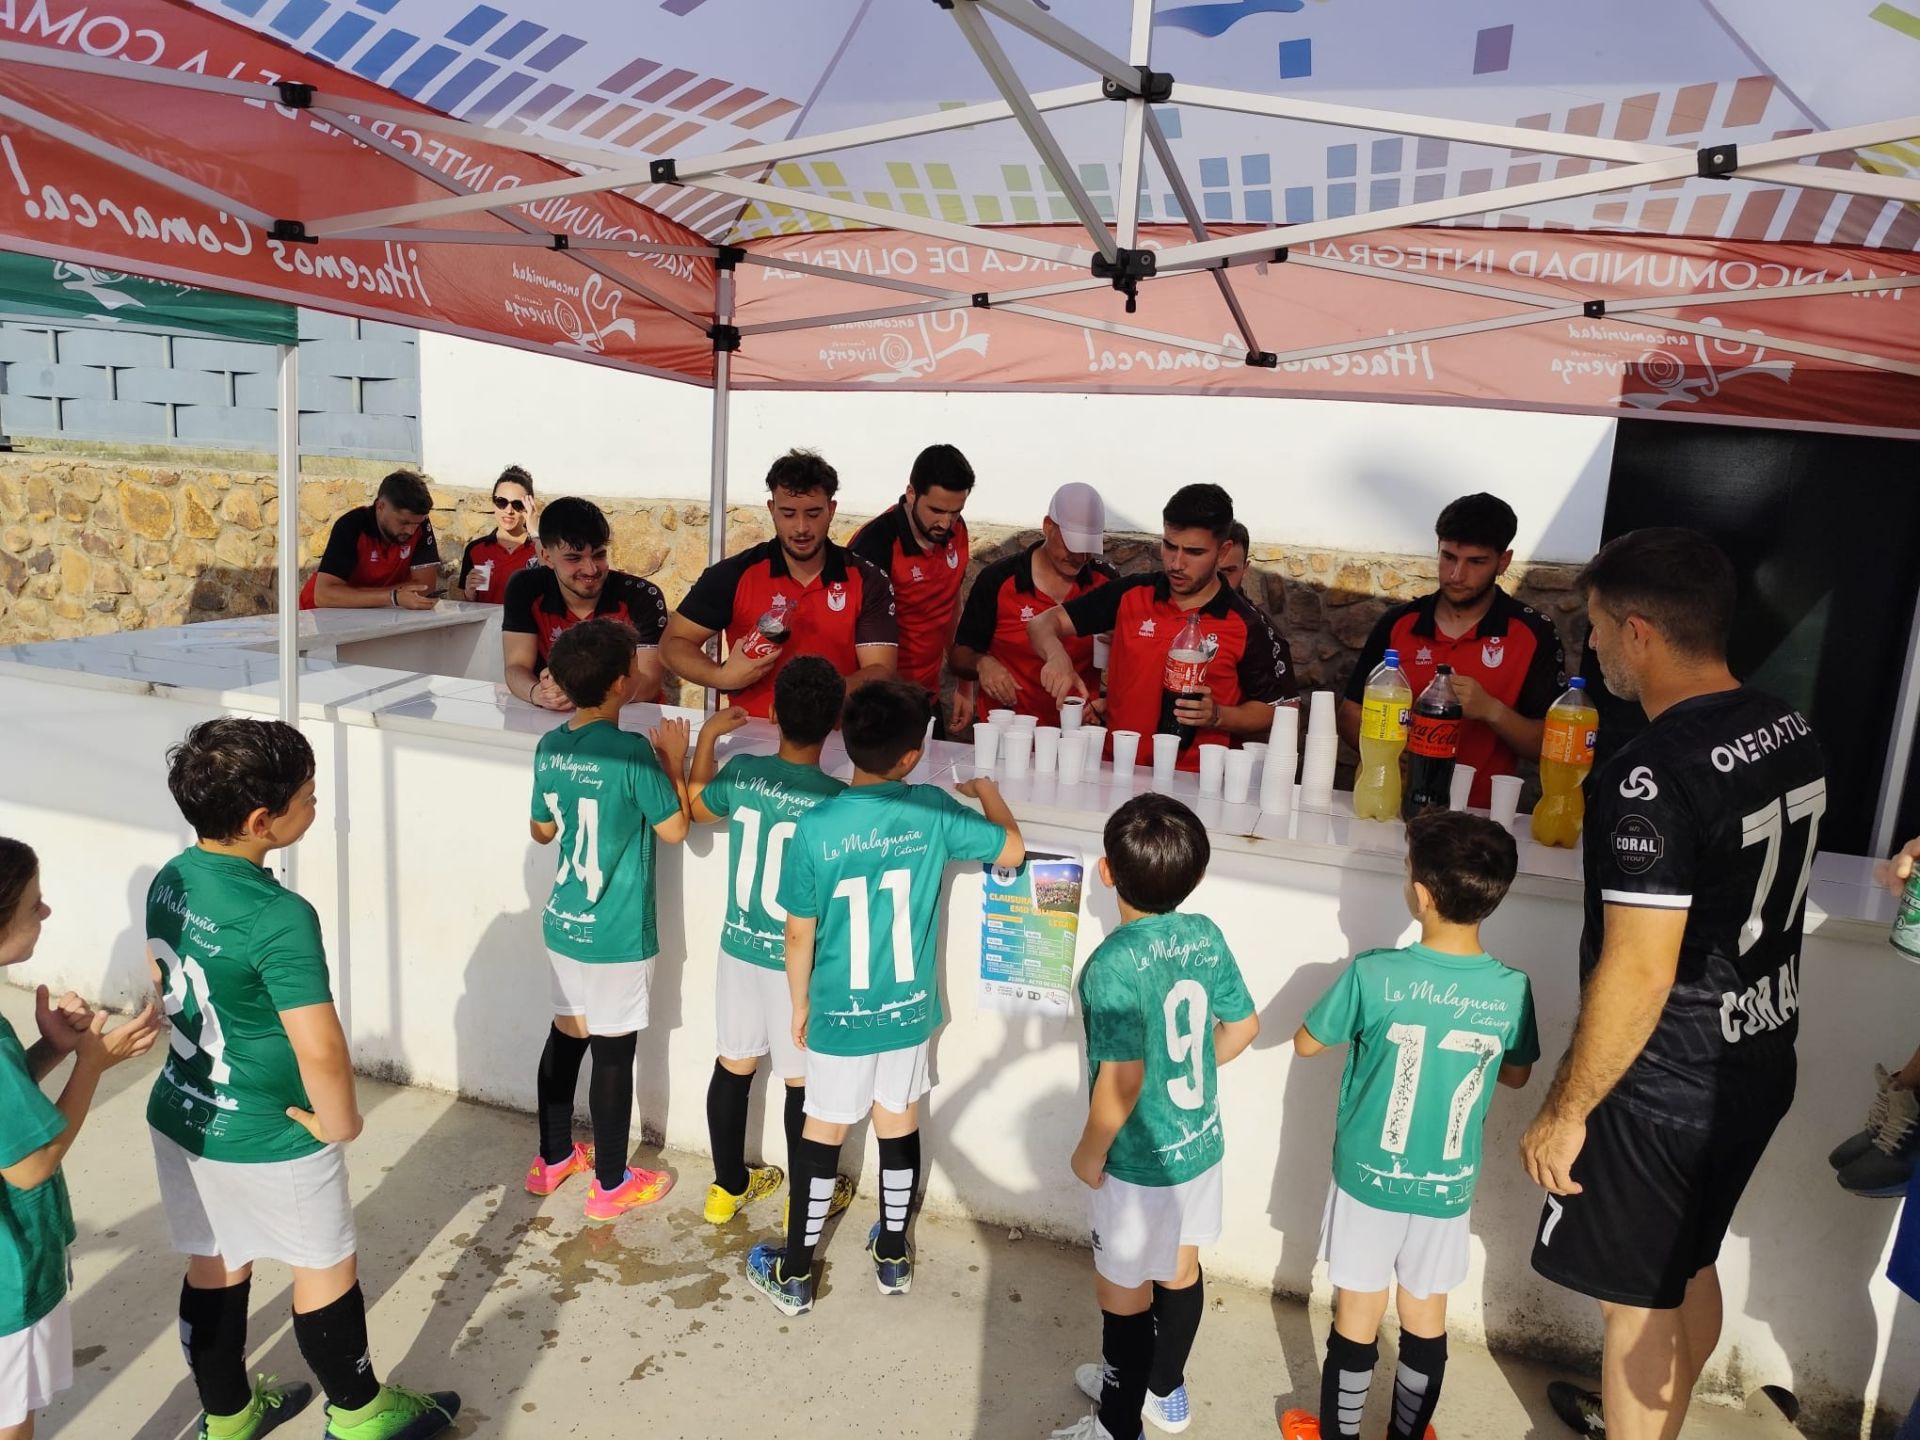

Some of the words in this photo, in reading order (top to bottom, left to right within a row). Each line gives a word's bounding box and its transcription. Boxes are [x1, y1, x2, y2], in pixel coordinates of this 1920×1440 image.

[543, 792, 603, 903] 14
[823, 841, 840, 861] La
[842, 828, 923, 858] Malagueña
[894, 844, 928, 857] Catering
[1616, 837, 1657, 853] CORAL
[1738, 776, 1826, 956] 77
[543, 911, 593, 938] LVERDE
[832, 869, 914, 989] 11
[1129, 948, 1150, 970] La
[1384, 977, 1404, 1002] La
[1409, 980, 1508, 1019] Malagueña
[828, 1002, 926, 1029] VALVERDE
[1470, 1013, 1510, 1032] Catering
[1164, 979, 1207, 1110] 9
[1380, 1022, 1501, 1160] 17
[1358, 1169, 1472, 1199] VALVERDE
[1541, 1193, 1563, 1247] 7
